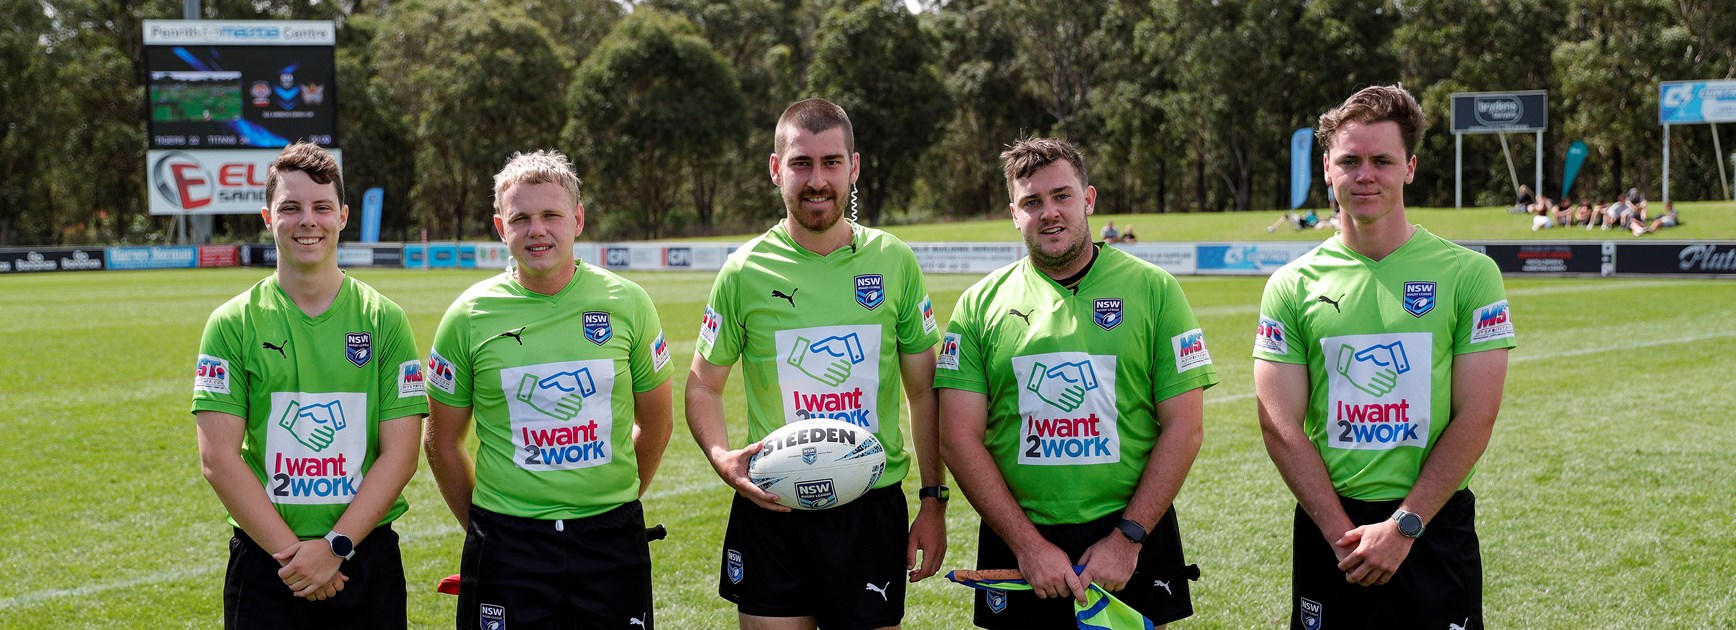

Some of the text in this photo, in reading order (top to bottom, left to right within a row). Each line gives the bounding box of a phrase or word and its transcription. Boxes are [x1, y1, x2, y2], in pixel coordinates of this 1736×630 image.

[858, 278, 880, 286] NSW
[585, 315, 607, 323] NSW
[348, 335, 369, 344] NSW
[793, 387, 862, 412] I want
[1337, 399, 1409, 423] I want
[522, 419, 598, 448] I want
[1028, 413, 1100, 438] I want
[1338, 420, 1418, 443] 2work
[524, 440, 606, 465] 2work
[763, 428, 856, 457] STEEDEN
[1025, 435, 1112, 458] 2work
[274, 452, 347, 477] I want
[273, 473, 357, 497] 2work
[799, 483, 830, 495] NSW
[482, 606, 502, 616] NSW
[1302, 600, 1320, 613] NSW
